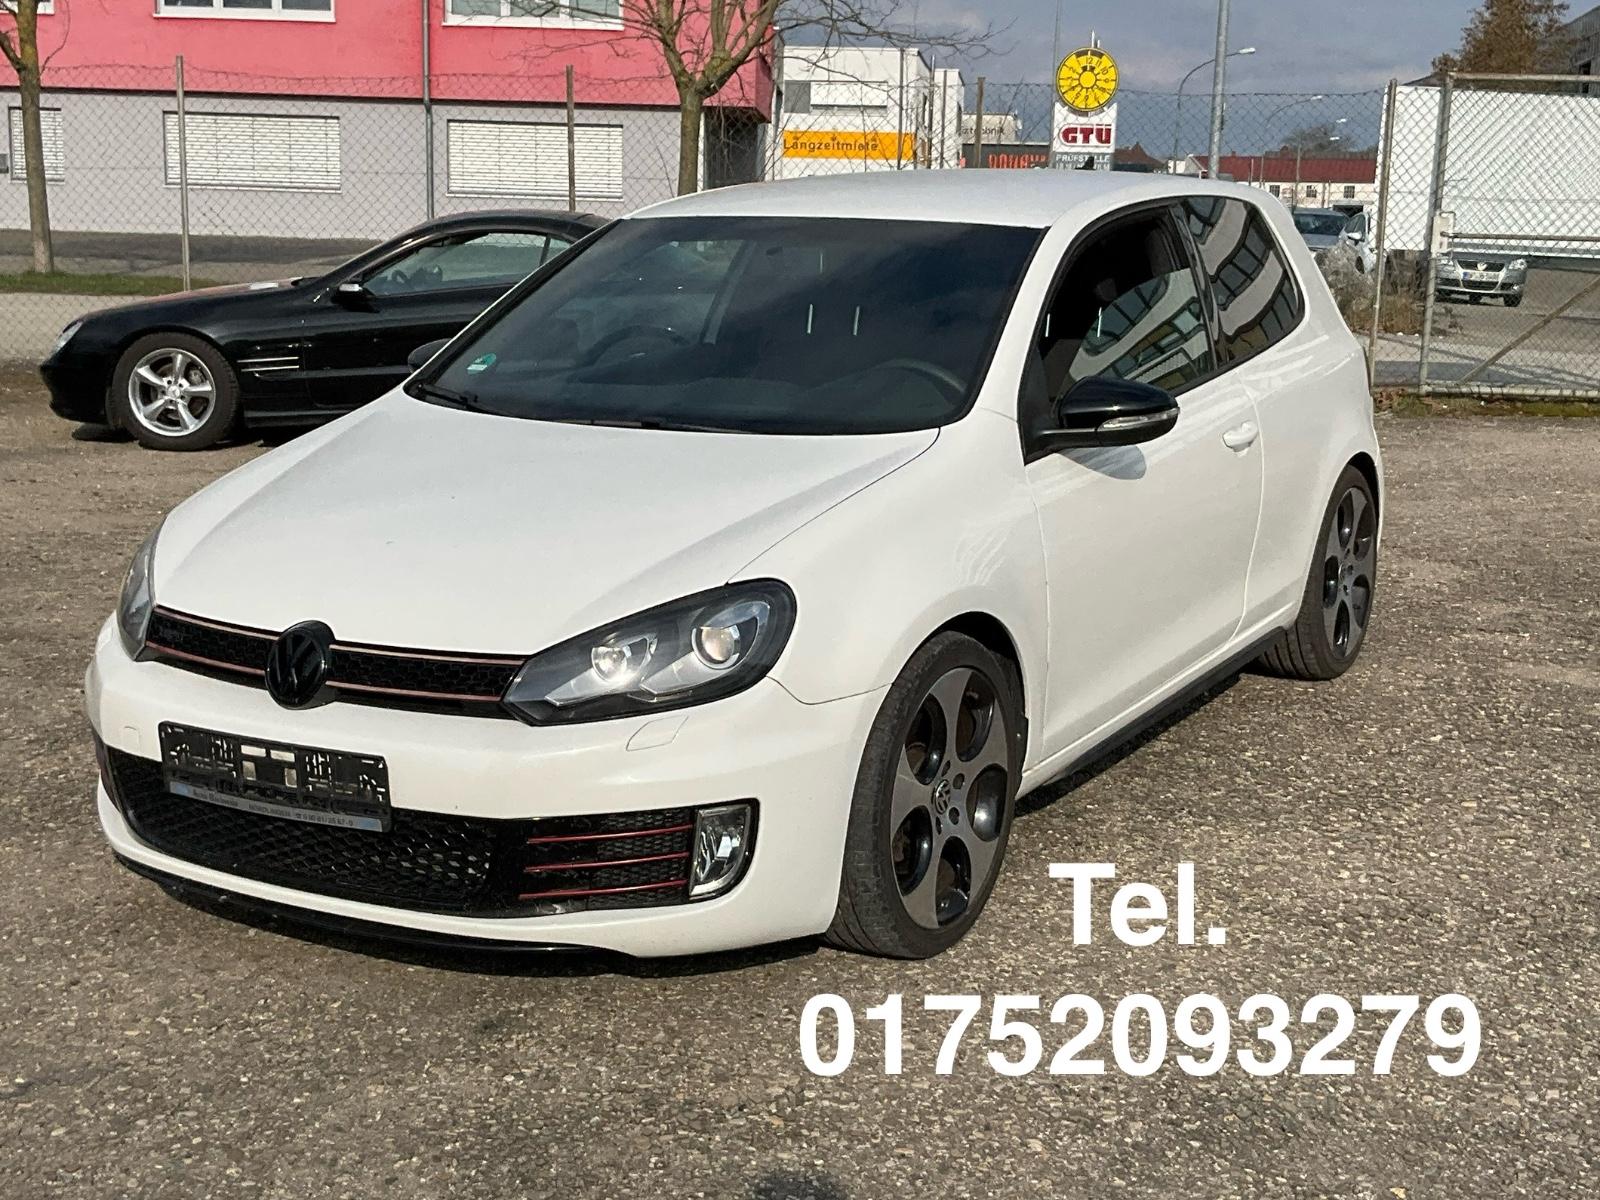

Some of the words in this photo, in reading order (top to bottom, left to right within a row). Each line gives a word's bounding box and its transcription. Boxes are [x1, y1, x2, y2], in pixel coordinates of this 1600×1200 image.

[1061, 124, 1112, 144] GTÜ
[783, 139, 879, 152] Langzeitmiete
[1055, 153, 1111, 162] PRÜFSTLLE
